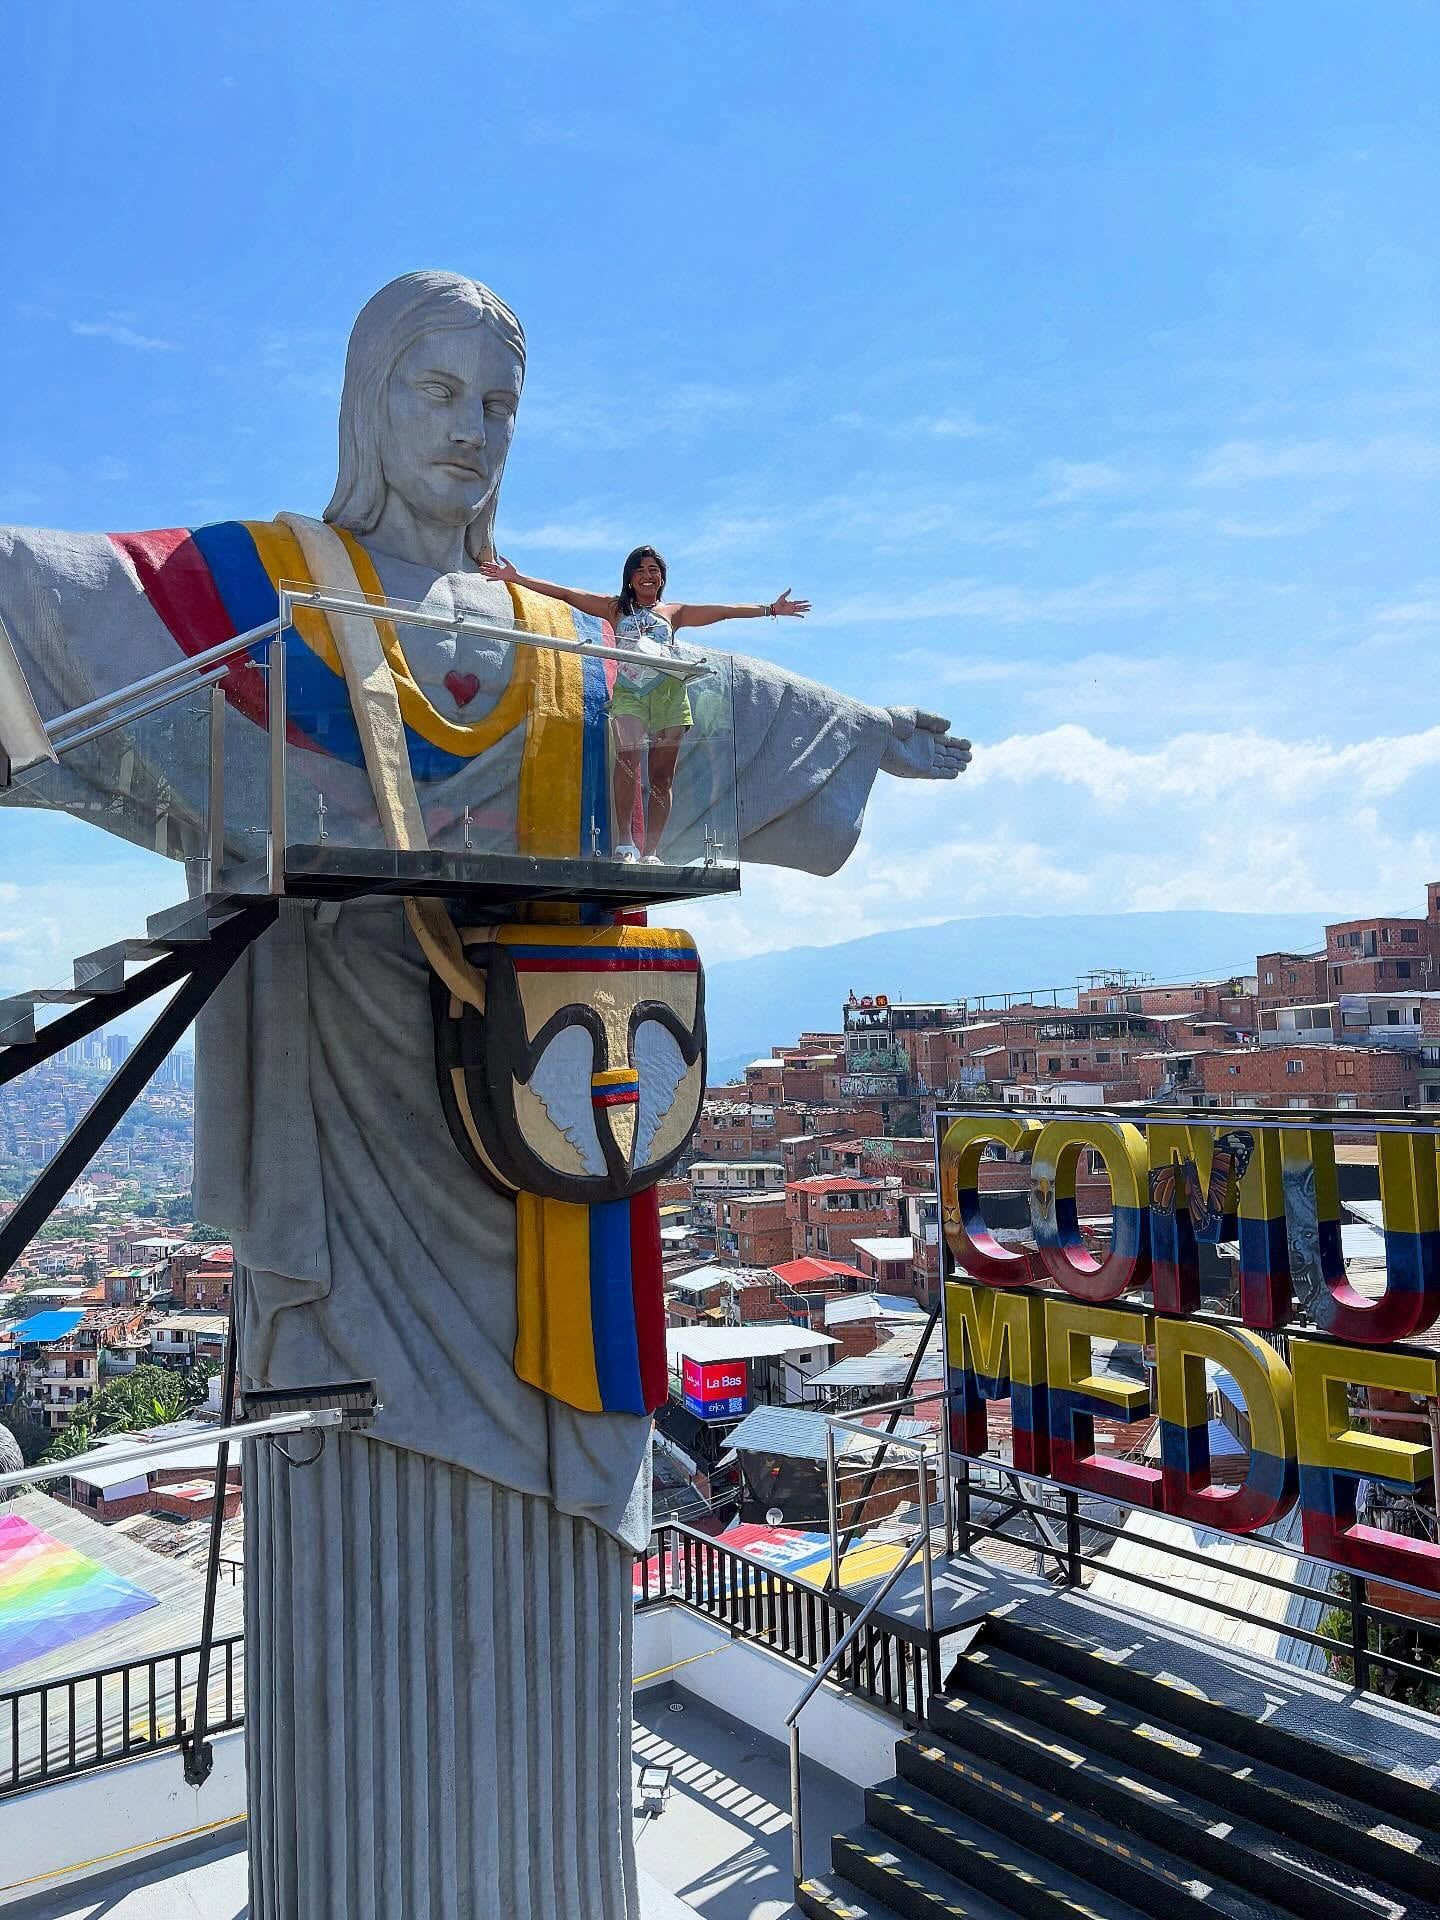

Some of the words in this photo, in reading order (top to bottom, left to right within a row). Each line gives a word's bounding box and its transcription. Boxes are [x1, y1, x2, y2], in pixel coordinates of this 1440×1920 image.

[941, 1113, 1440, 1344] COMU
[706, 1378, 720, 1388] La
[722, 1375, 742, 1387] Bas
[945, 1281, 1440, 1592] MEDE
